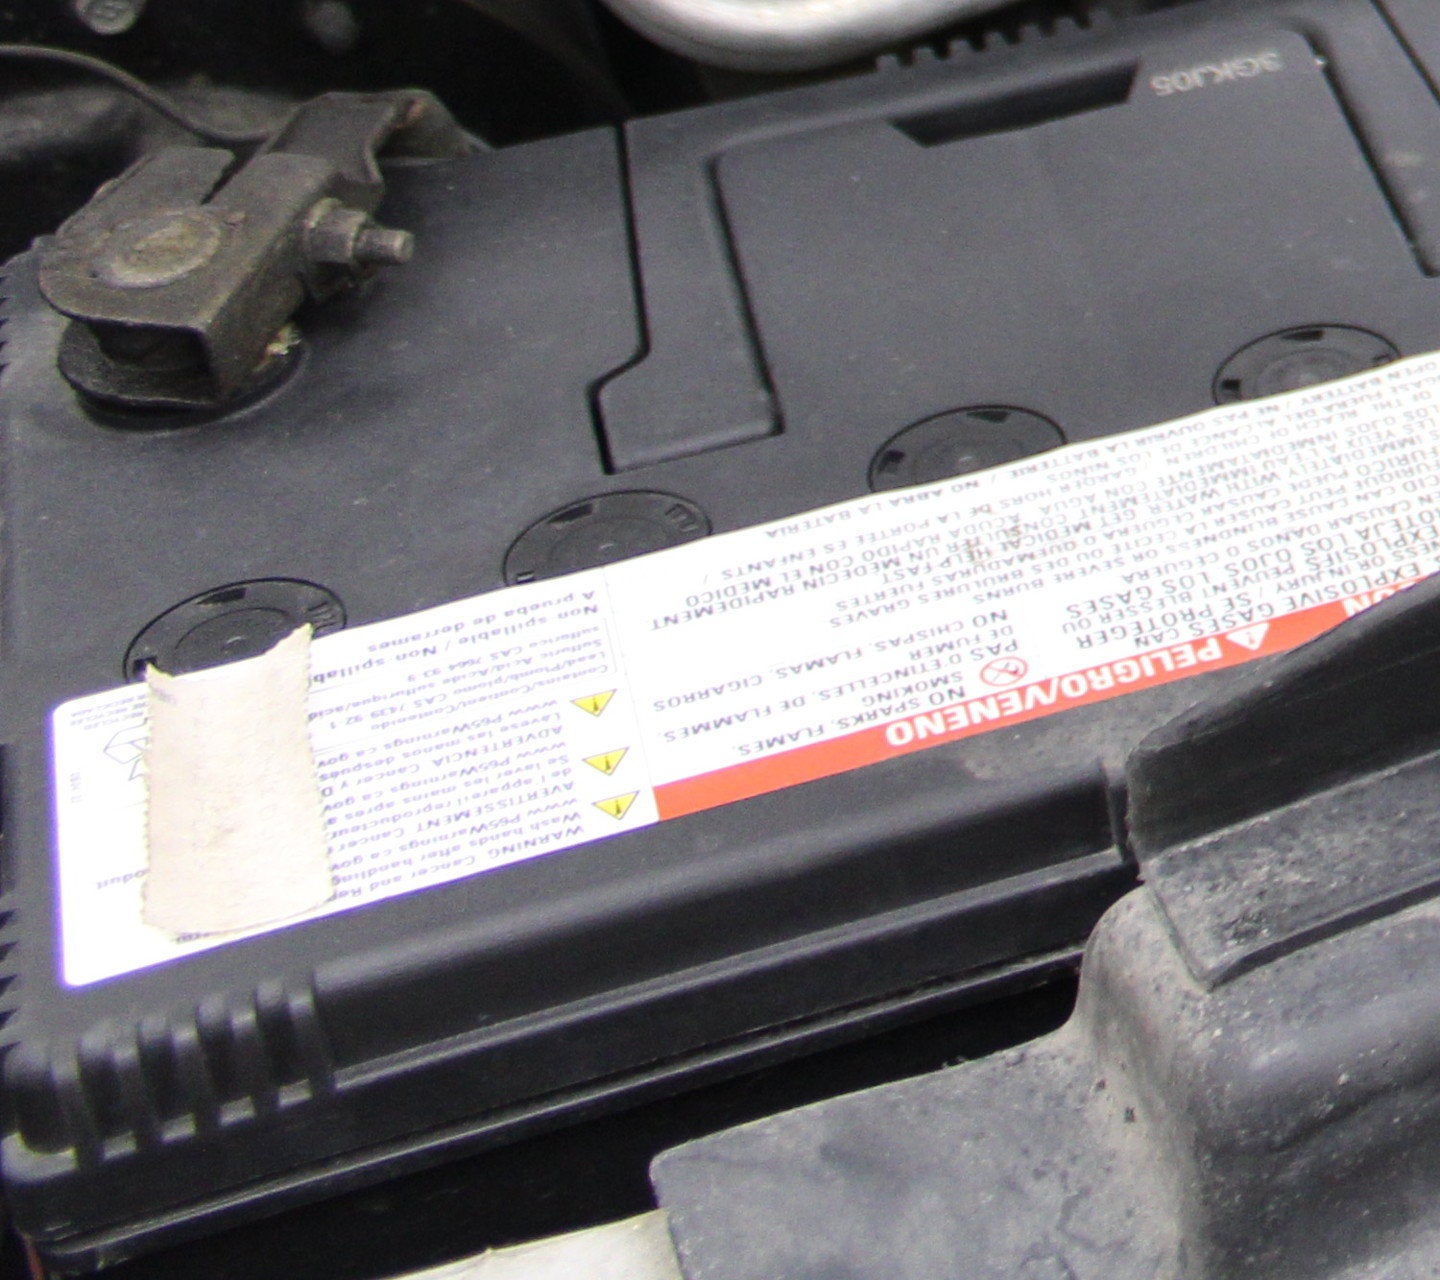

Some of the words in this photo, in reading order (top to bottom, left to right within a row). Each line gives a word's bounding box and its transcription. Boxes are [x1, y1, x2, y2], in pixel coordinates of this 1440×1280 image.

[1298, 531, 1348, 557] LOS
[1303, 522, 1440, 572] EXPLOSIFS
[1356, 554, 1386, 572] OR
[1159, 569, 1211, 595] LOS
[1201, 560, 1296, 598] PEUVENT
[1286, 560, 1421, 612] EXPLOSIVE
[1064, 584, 1153, 619] GASES
[1097, 589, 1193, 625] BLESSER
[1223, 590, 1252, 612] SE
[970, 608, 1008, 628] NO
[1060, 616, 1092, 635] OU
[1074, 602, 1213, 649] PROTEGER
[1186, 601, 1275, 638] GASES
[366, 620, 465, 653] derrames
[989, 623, 1014, 640] DE
[1132, 626, 1180, 649] CAN
[908, 633, 981, 661] FUMER
[968, 637, 1019, 661] PAS
[651, 673, 763, 712] CIGARROS
[860, 670, 963, 706] SMOKING
[884, 630, 1222, 746] PELIGRO/VENENO
[927, 684, 966, 706] NO
[781, 694, 806, 711] DE
[467, 825, 524, 847] hands
[419, 843, 461, 862] after
[367, 873, 402, 893] and
